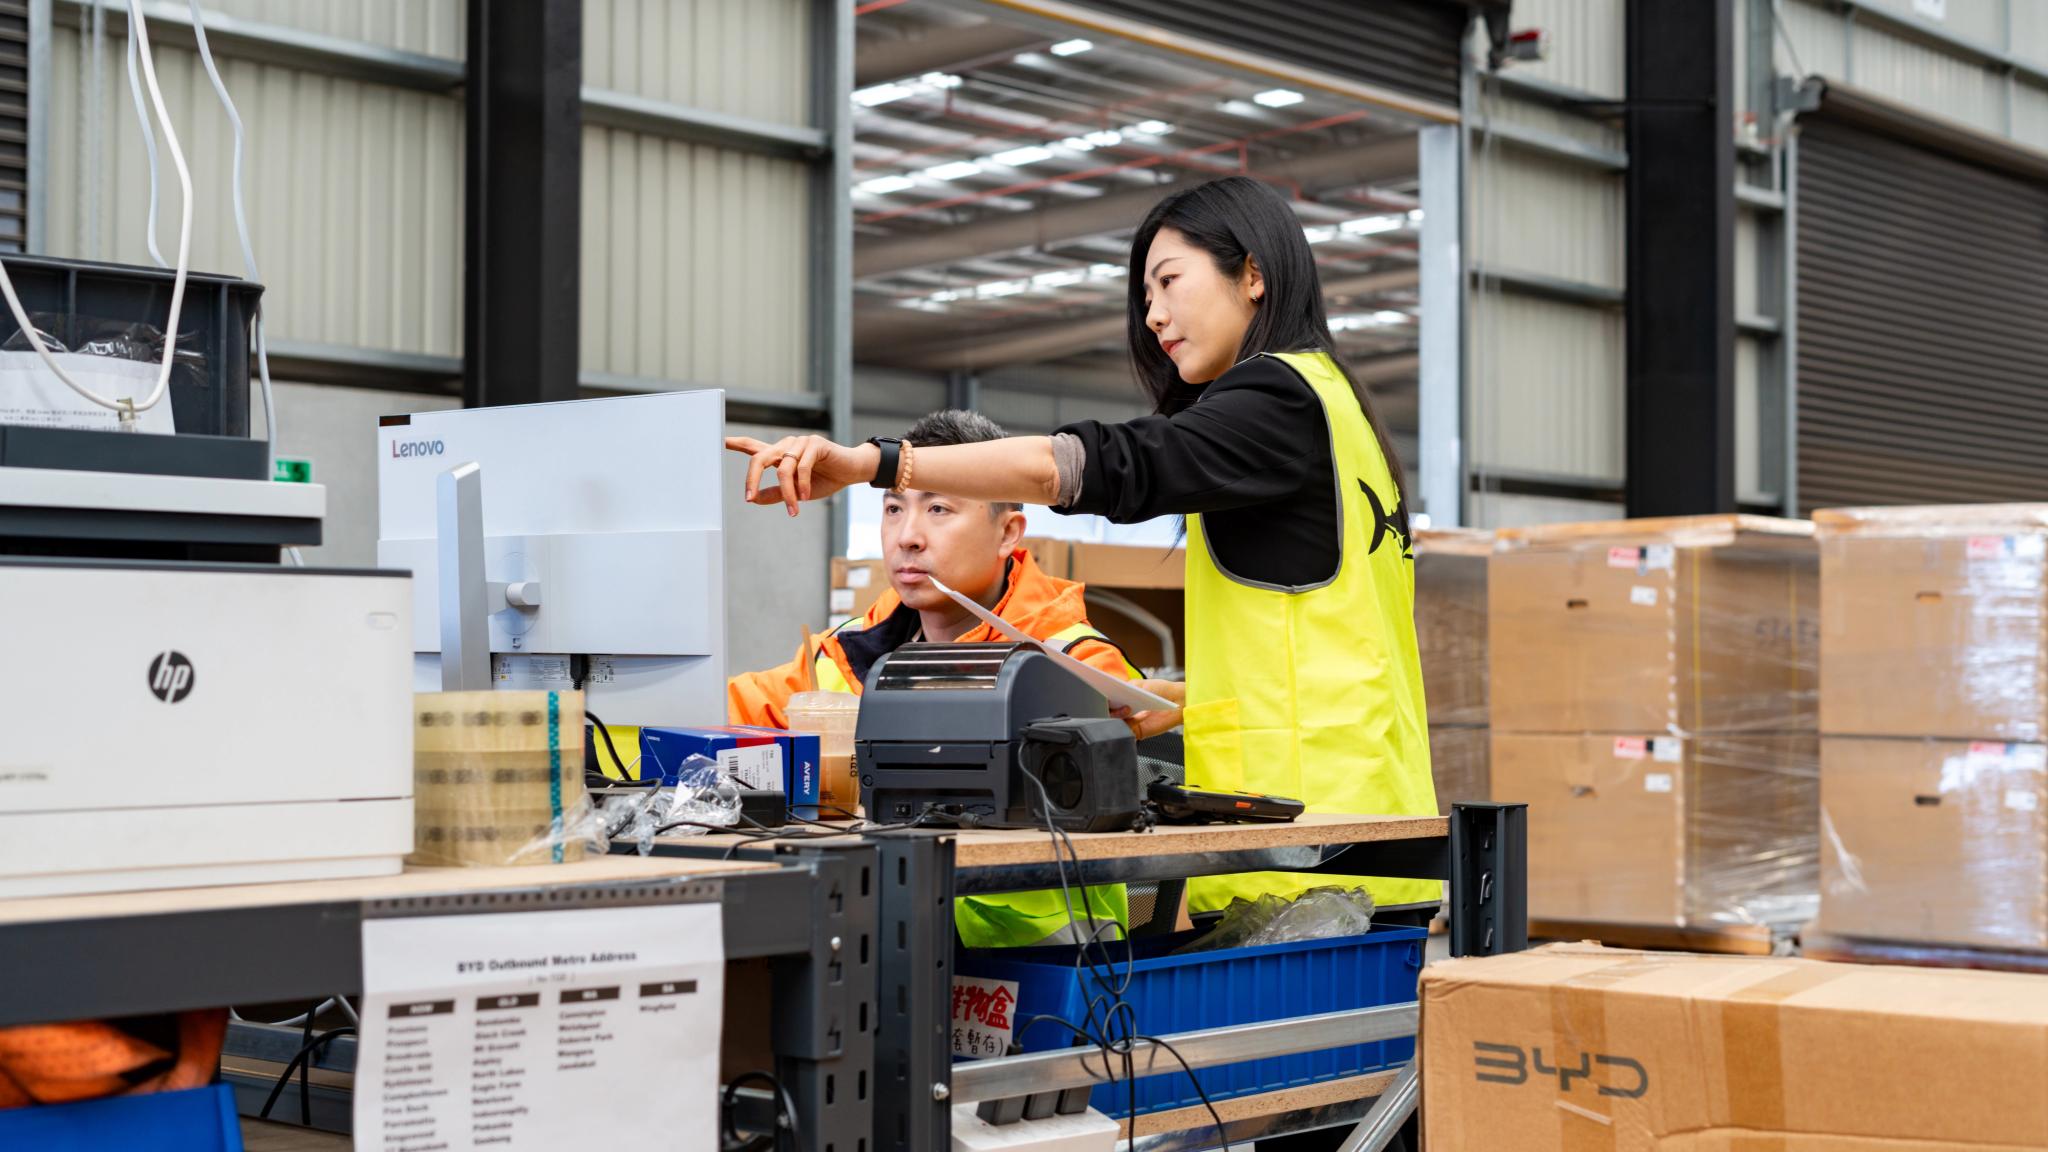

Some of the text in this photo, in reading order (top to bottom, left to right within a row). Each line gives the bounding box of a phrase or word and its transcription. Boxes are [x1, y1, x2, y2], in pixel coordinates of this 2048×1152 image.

[392, 440, 444, 458] Lenovo
[149, 650, 194, 704] hp
[802, 761, 812, 795] AVERY
[457, 951, 638, 974] BYD Outbound Metro Address
[1474, 1041, 1649, 1099] BYD
